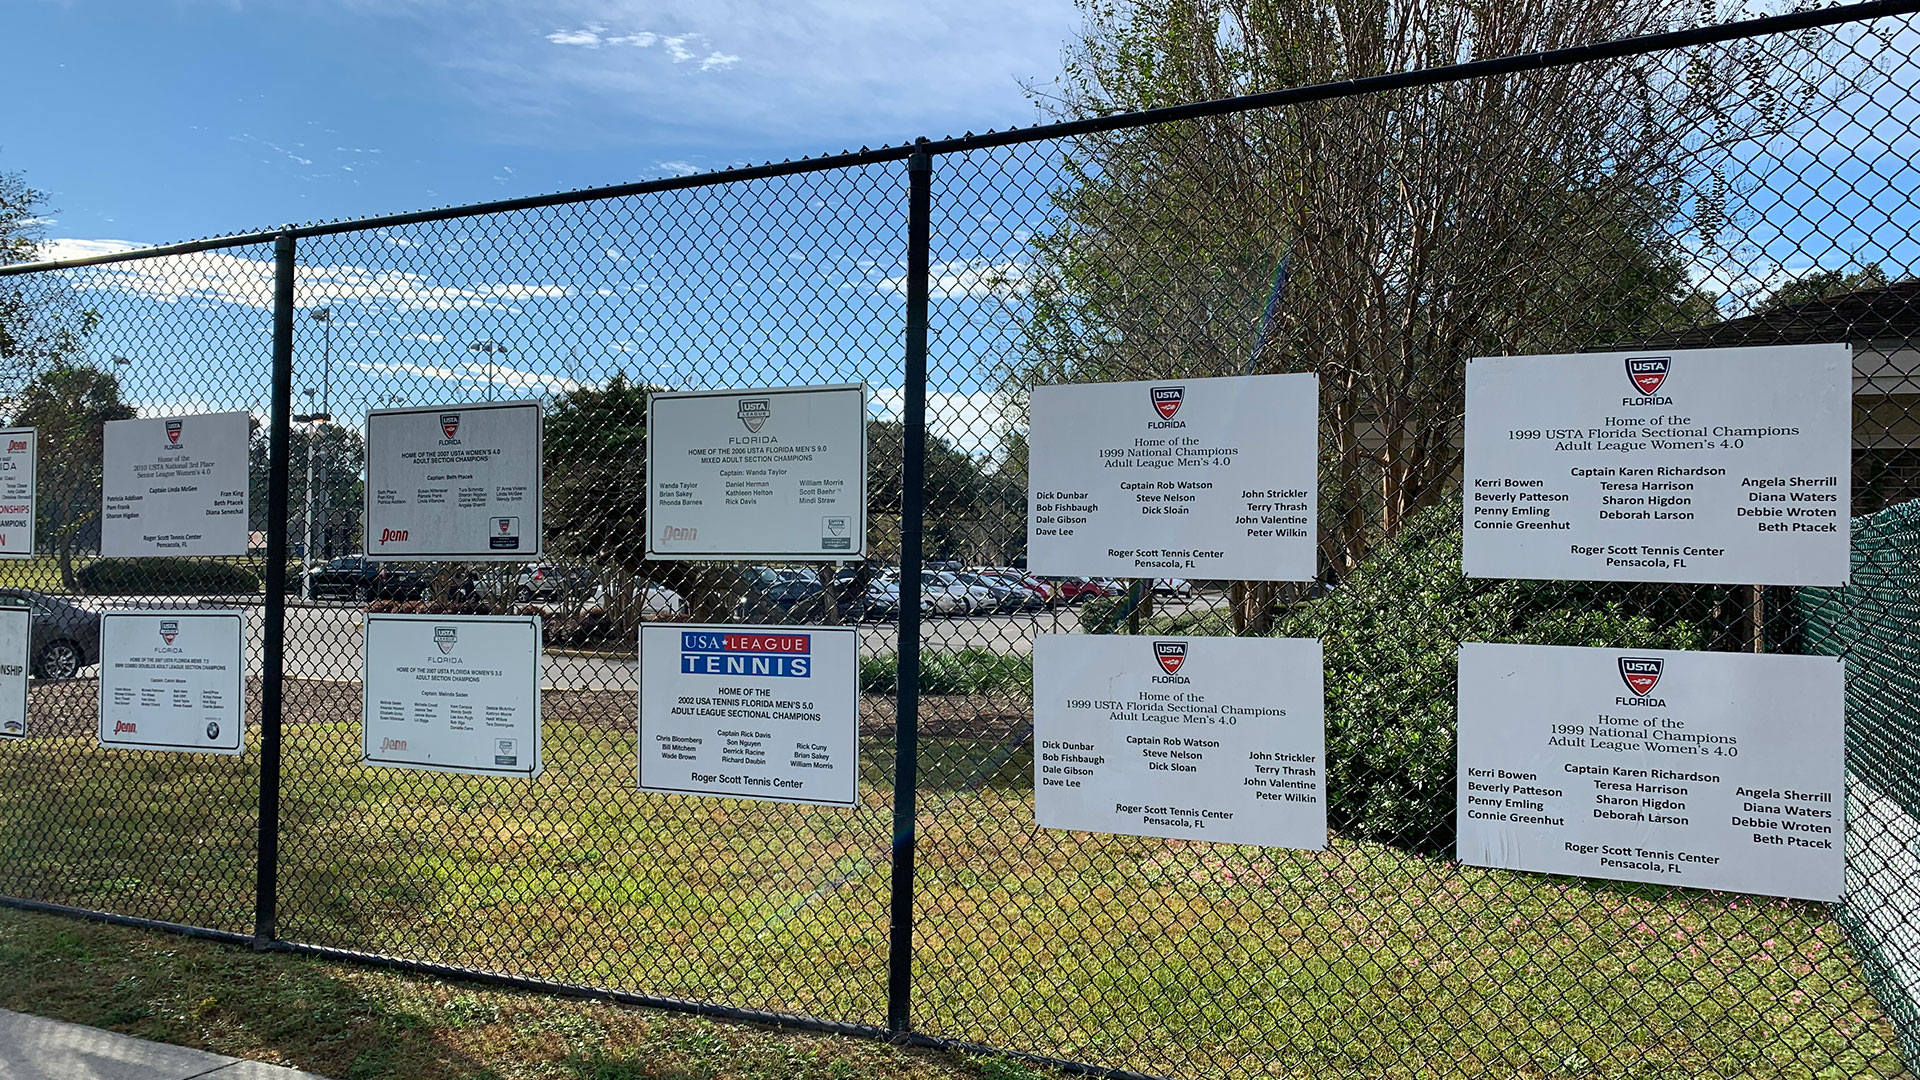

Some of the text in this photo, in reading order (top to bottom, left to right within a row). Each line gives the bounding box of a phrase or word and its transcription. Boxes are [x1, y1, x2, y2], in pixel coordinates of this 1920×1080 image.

[1633, 362, 1665, 372] USTA
[1156, 390, 1180, 399] USTA
[743, 402, 765, 411] USTA
[1622, 396, 1673, 406] FLORIDA
[1148, 420, 1186, 430] FLORIDA
[1605, 415, 1691, 426] Home of the
[1509, 426, 1799, 440] 1999 USTA Florida Sectional Champions
[728, 436, 778, 445] FLORIDA
[1099, 447, 1238, 458] 1999 National Champions
[744, 455, 772, 463] SECTION
[773, 454, 813, 462] CHAMPIONS
[1104, 457, 1230, 468] Adult League Men's 4.0
[1571, 466, 1725, 478] Captain Karen Richardson
[1120, 481, 1212, 491] Captain Rob Watson
[1475, 478, 1543, 487] Kerri Bowen
[1741, 477, 1837, 489] Angela Sherrill
[1057, 491, 1088, 499] Dunbar
[1241, 489, 1308, 498] John Strickler
[1475, 492, 1568, 503] Beverly Patteson
[1749, 492, 1837, 502] Diana Waters
[1055, 504, 1098, 513] Fishbaugh
[1247, 502, 1307, 512] Terry Thrash
[1108, 549, 1224, 558] Roger Scott Tennis Center
[1607, 558, 1687, 569] Pensacola, FL
[684, 635, 803, 651] USA LEAGUE
[1159, 646, 1183, 654] USTA
[684, 655, 807, 676] TENNIS
[1626, 662, 1658, 672] USTA
[1152, 675, 1190, 684] FLORIDA
[719, 687, 770, 697] HOME OF THE
[1139, 692, 1204, 702] Home of the
[678, 696, 813, 710] 2002 USA TENNIS FLORIDA MEN'S 5.0
[1615, 697, 1666, 708] FLORIDA
[1067, 700, 1286, 717] 1999 USTA Florida Sectional Champions
[717, 729, 739, 737] Captain
[1552, 724, 1737, 744] 1999 National Champions
[672, 736, 702, 745] Bloomberg
[1548, 737, 1738, 757] Adult League Women's 4.0
[1143, 749, 1202, 759] Steve Nelson
[1043, 765, 1093, 775] Dale Gibson
[691, 772, 803, 788] Roger Scott Tennis Center
[1043, 778, 1080, 787] Dave Lee
[1244, 777, 1316, 790] John Valentine
[1594, 780, 1688, 795] Teresa Harrison
[1256, 791, 1316, 803] Peter Wilkin
[1596, 794, 1685, 810] Sharon Higdon
[1468, 796, 1544, 811] Penny Emling
[1144, 816, 1205, 828] Pensacola, FL
[1468, 810, 1564, 826] Connie Greenhut
[1732, 817, 1831, 833] Debbie Wroten
[1753, 833, 1832, 849] Beth Ptacek
[1565, 842, 1720, 864] Roger Scott Tennis Center
